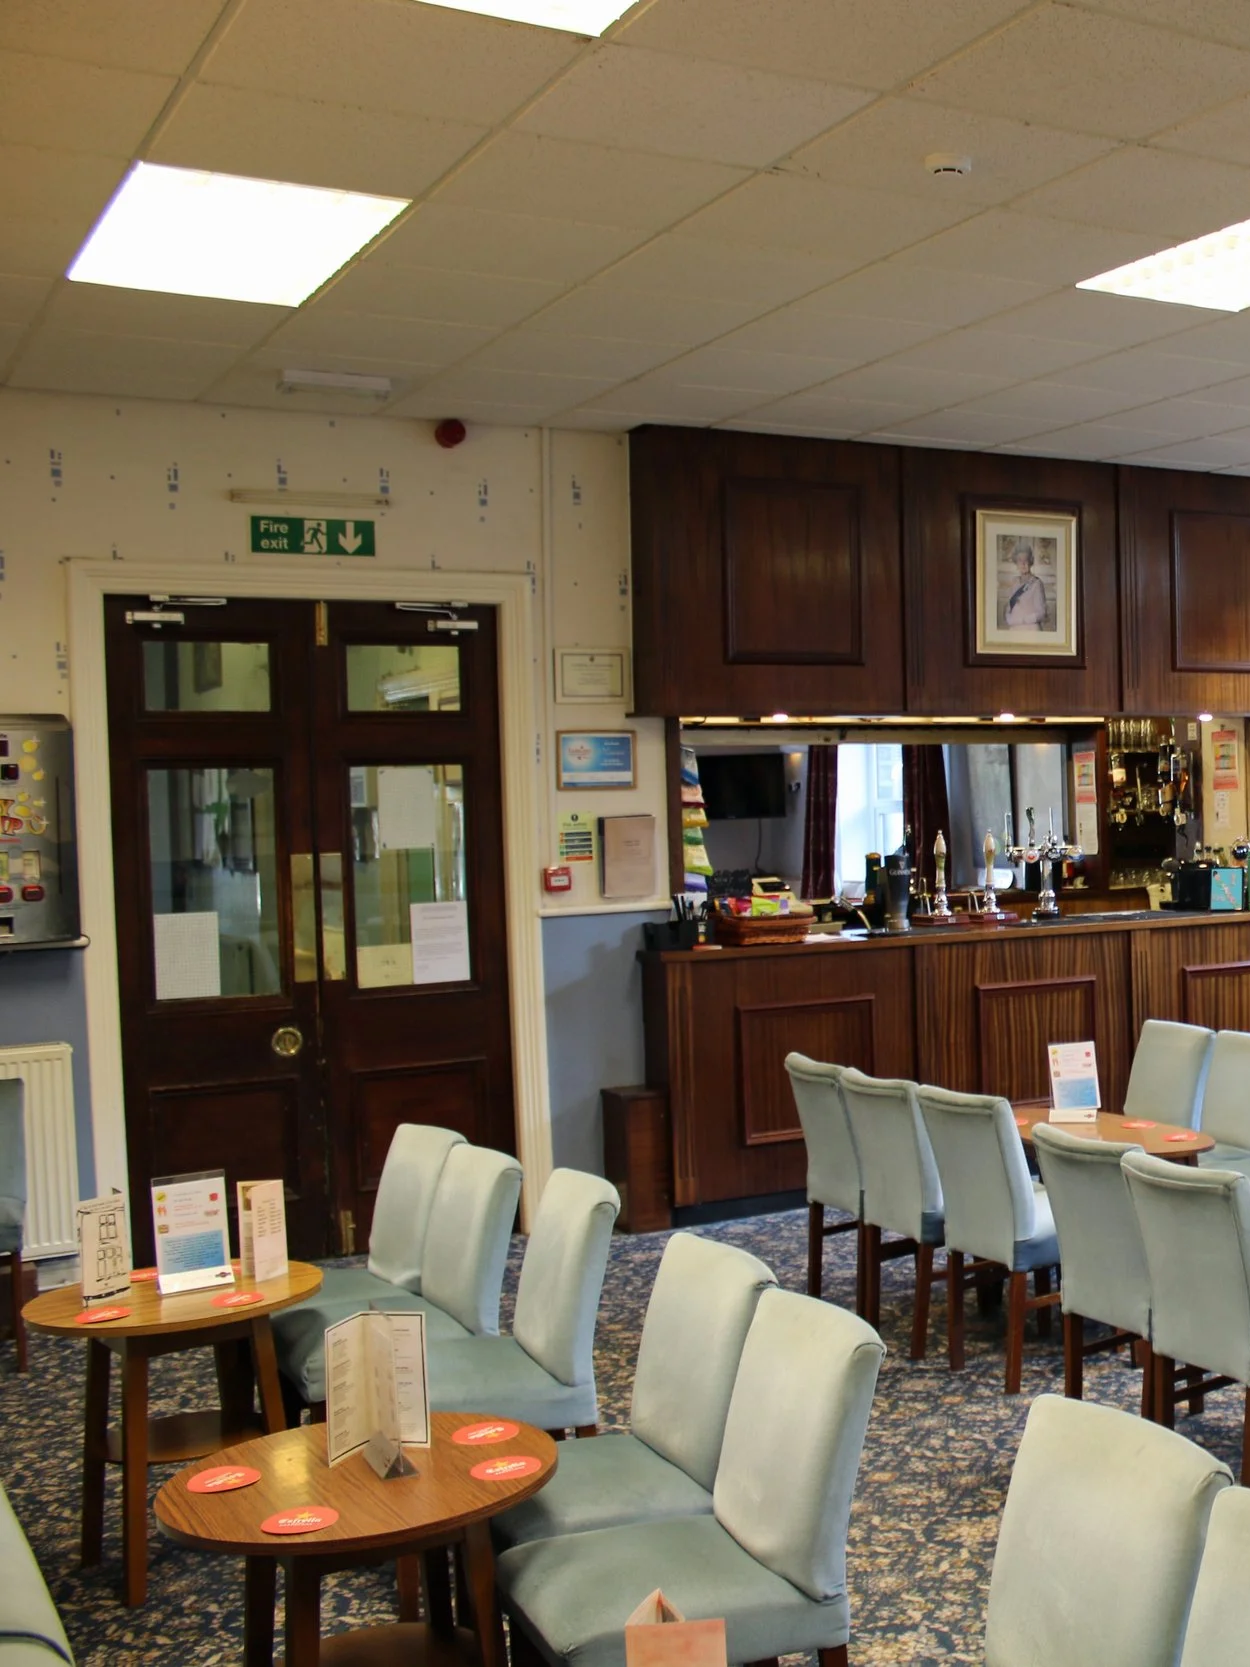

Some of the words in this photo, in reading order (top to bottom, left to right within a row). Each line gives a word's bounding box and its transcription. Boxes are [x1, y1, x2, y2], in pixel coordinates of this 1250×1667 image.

[260, 519, 288, 533] Fire
[260, 537, 288, 549] exit
[278, 1516, 323, 1525] Estrella
